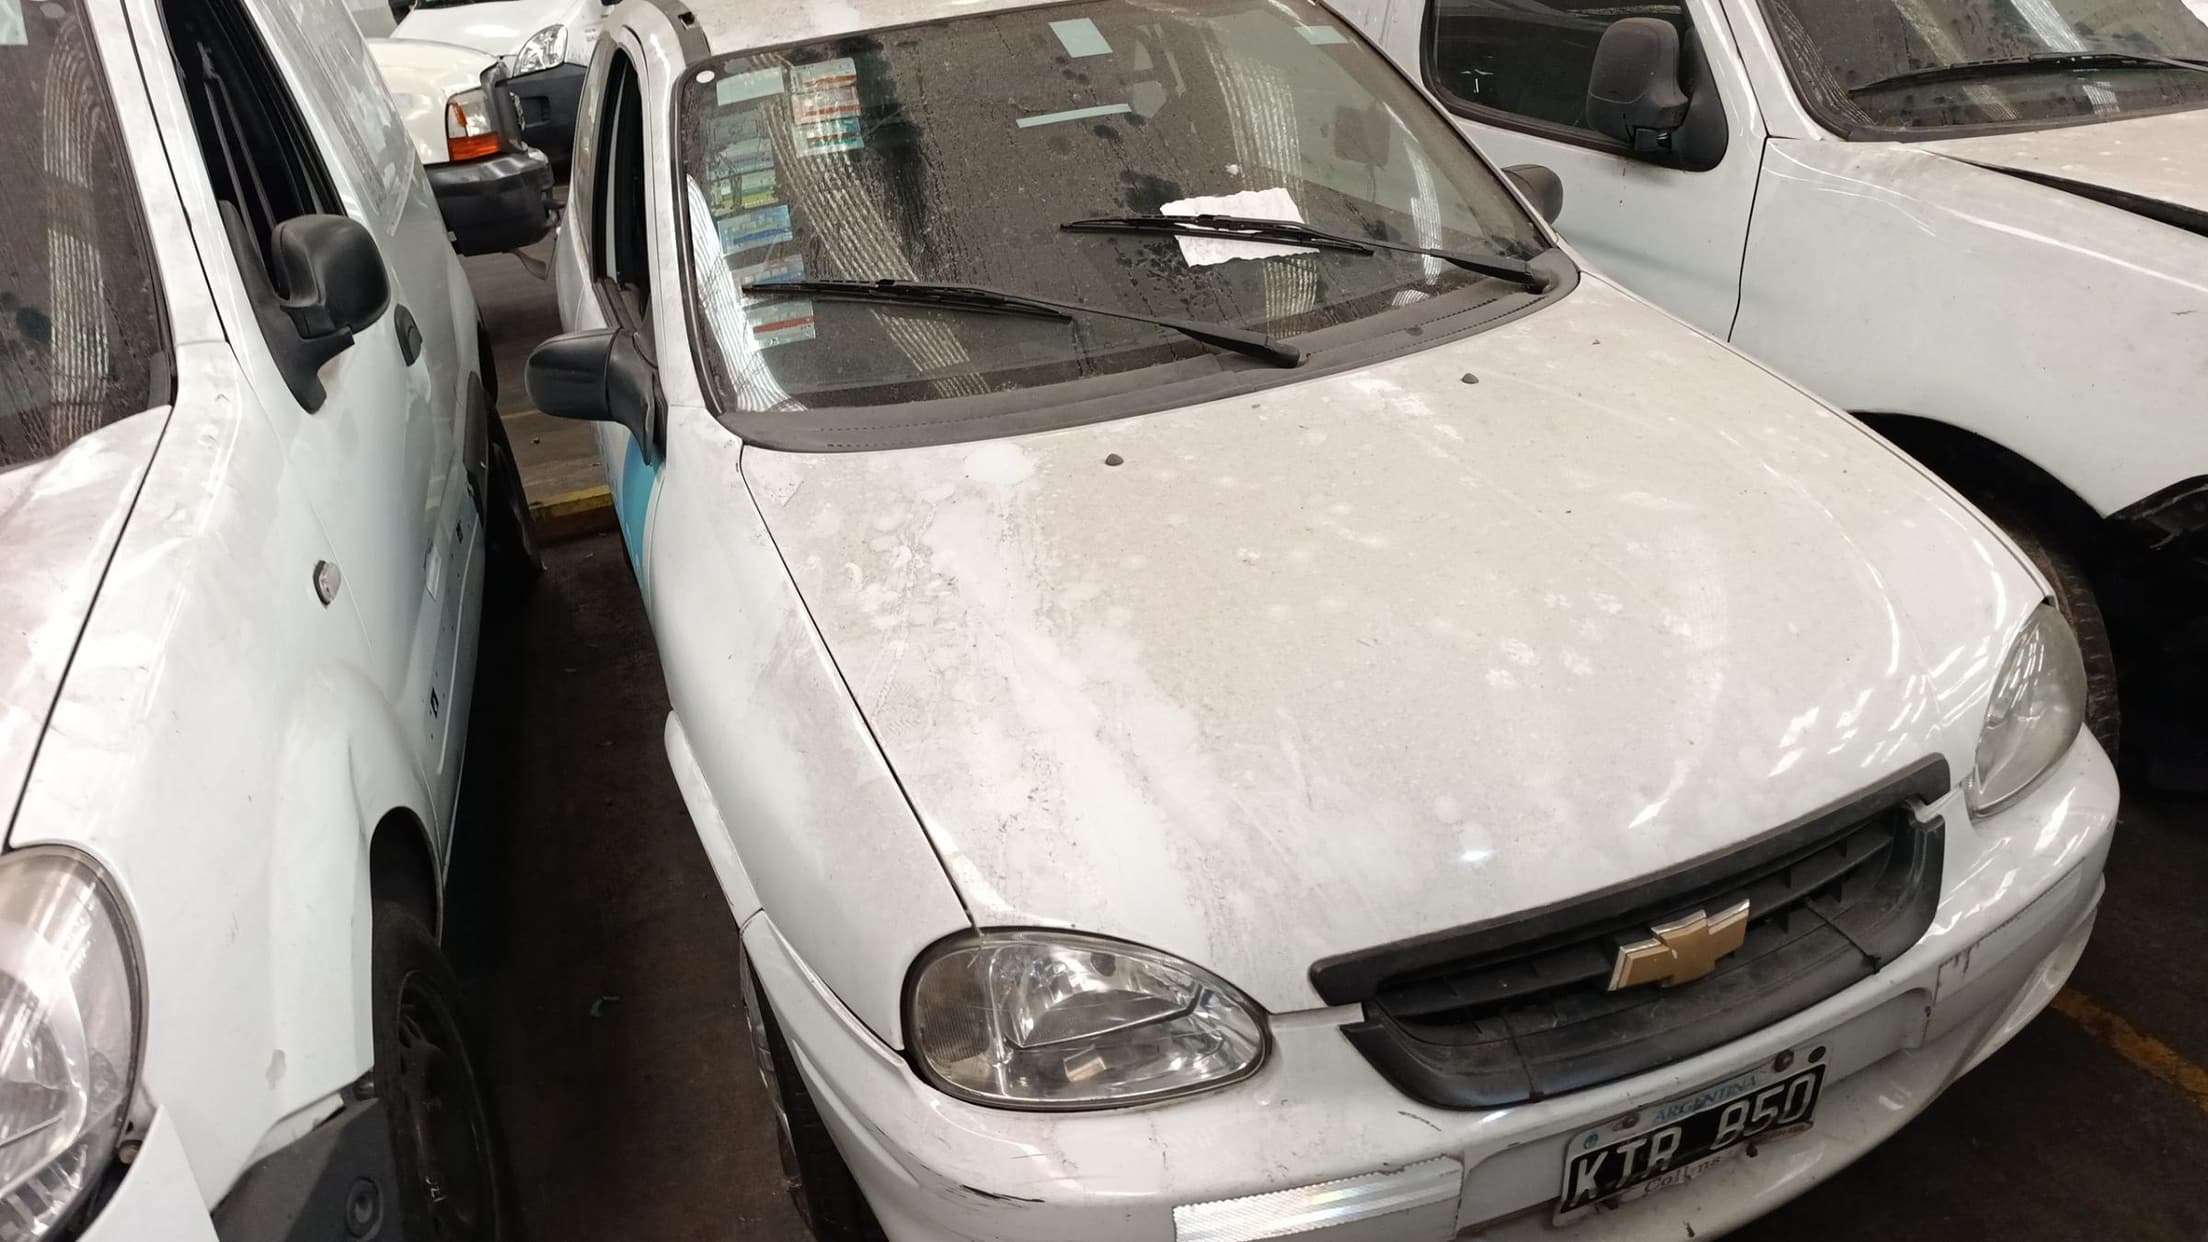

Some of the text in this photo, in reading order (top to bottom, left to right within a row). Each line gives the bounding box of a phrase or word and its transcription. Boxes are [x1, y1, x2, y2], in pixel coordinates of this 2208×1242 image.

[1655, 1074, 1759, 1121] ARGENTINA
[1572, 1126, 1682, 1207] KTR
[1645, 1157, 1721, 1194] Collns
